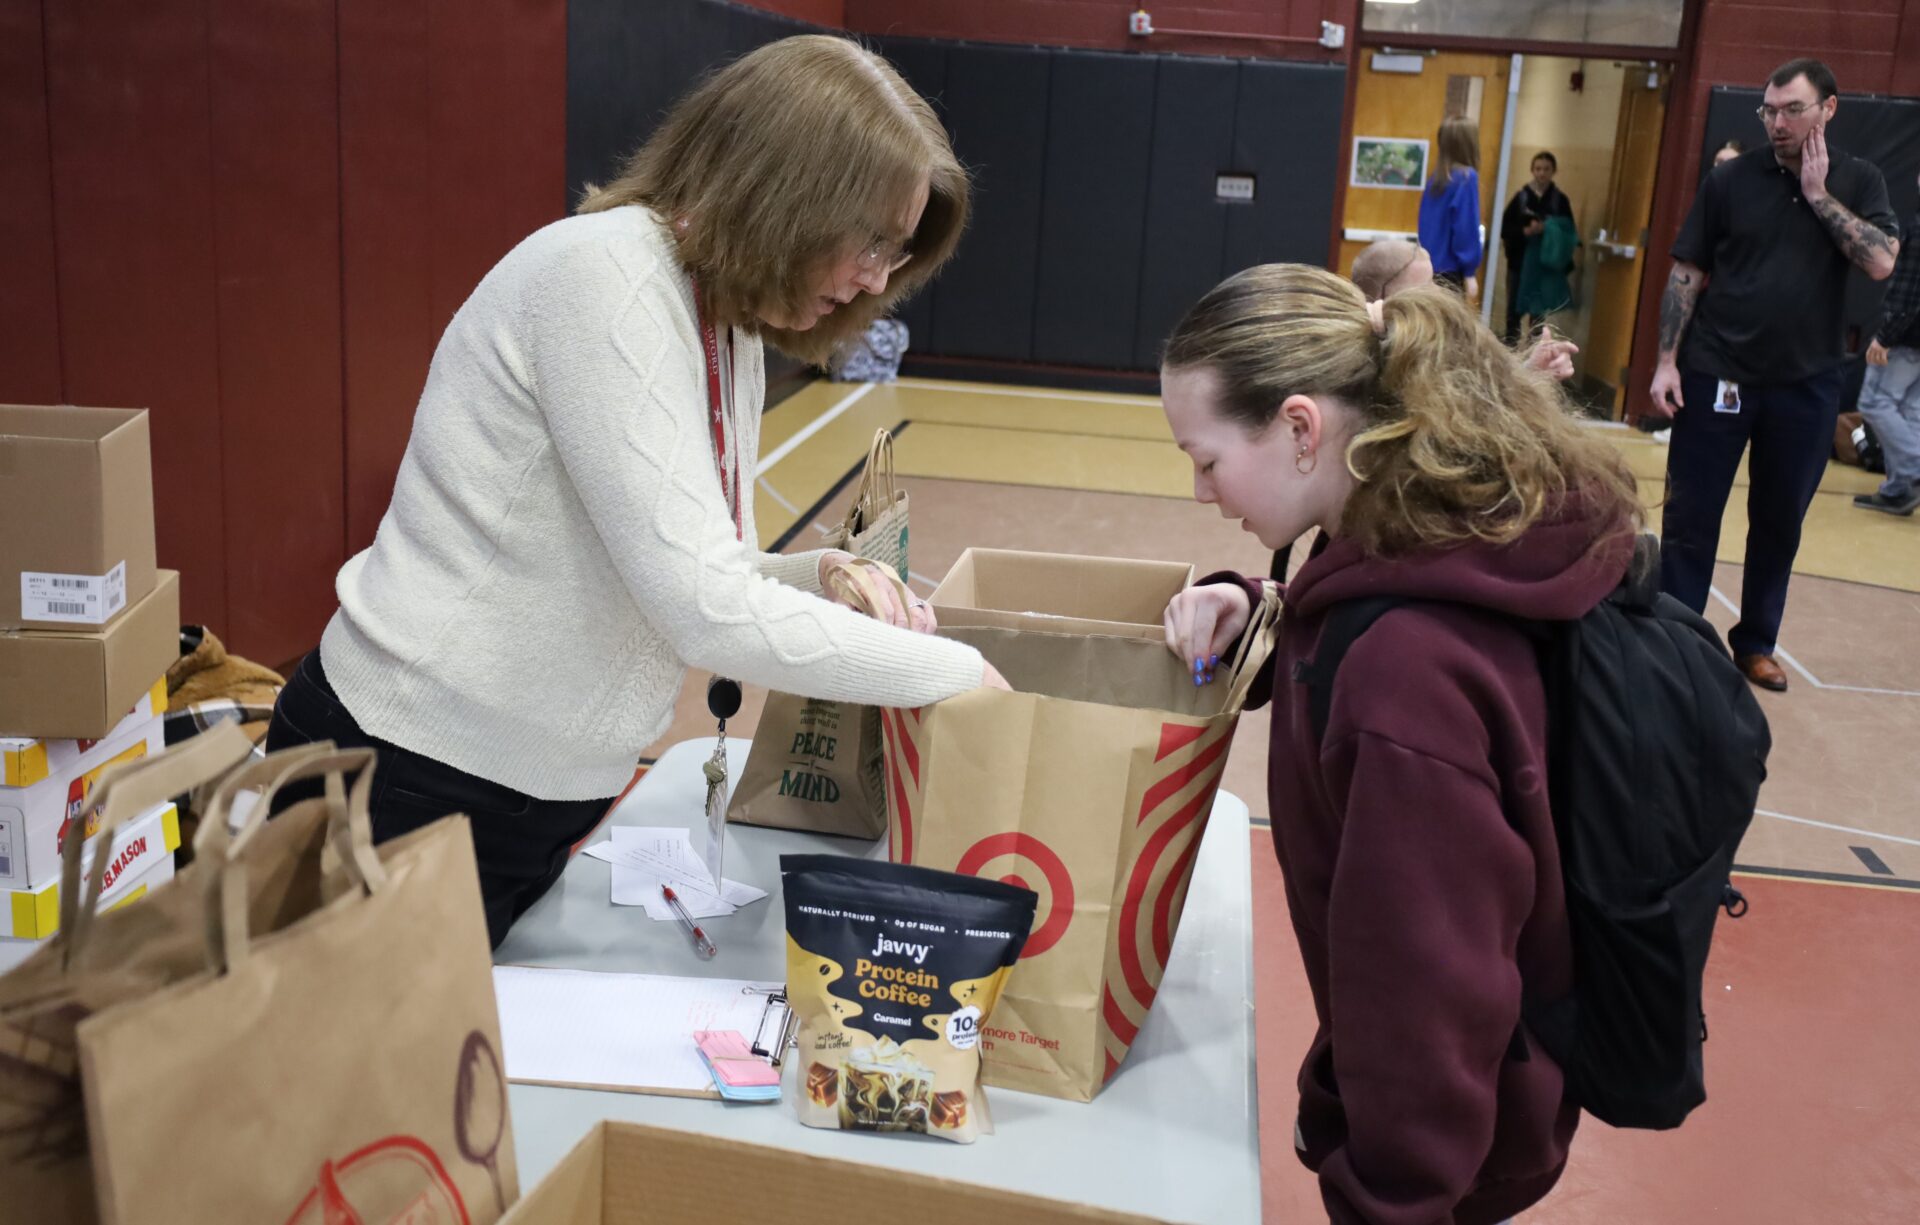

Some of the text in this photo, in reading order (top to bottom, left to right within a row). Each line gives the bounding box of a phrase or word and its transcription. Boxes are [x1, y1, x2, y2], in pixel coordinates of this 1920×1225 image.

[790, 732, 837, 761] PEACE
[778, 769, 840, 803] MIND
[98, 836, 147, 894] .B.MASON
[798, 905, 841, 918] NATURALLY
[843, 911, 876, 923] DERIVED
[907, 921, 918, 929] OF
[919, 922, 945, 933] SUGAR
[964, 929, 1011, 940] PREBIOTICS
[872, 933, 929, 964] javvy
[854, 958, 940, 990] Protein
[858, 979, 932, 1008] Coffee
[873, 1012, 912, 1027] Caramel
[982, 1026, 1060, 1051] more Target
